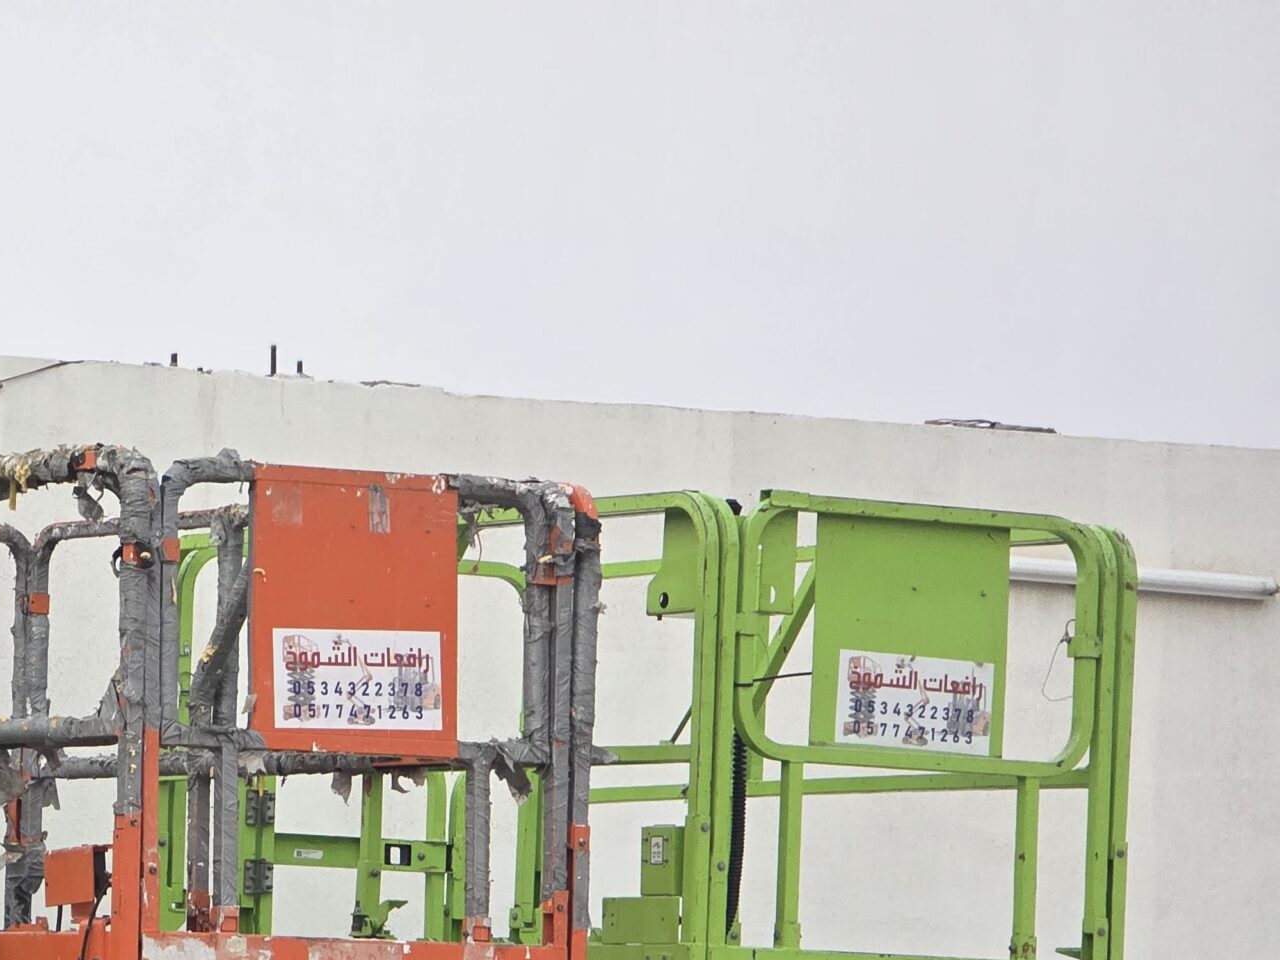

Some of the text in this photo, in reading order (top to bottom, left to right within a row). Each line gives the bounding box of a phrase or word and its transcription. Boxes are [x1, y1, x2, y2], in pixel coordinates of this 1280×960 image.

[285, 645, 430, 673] رافعات الشموخ
[849, 666, 984, 701] رافعات الشموخ
